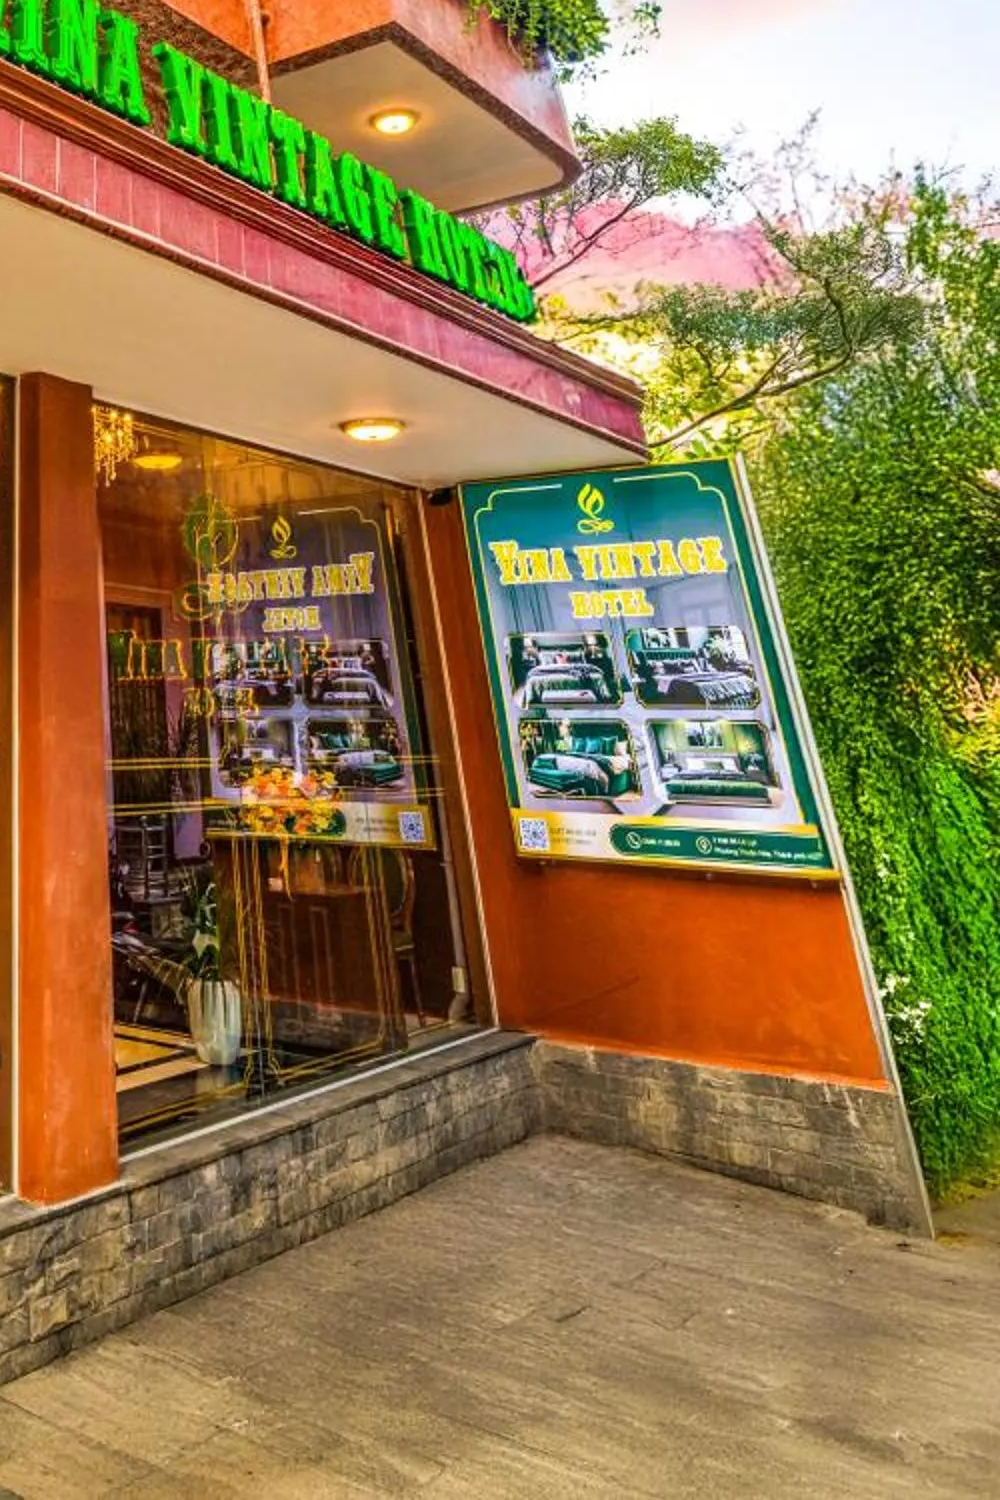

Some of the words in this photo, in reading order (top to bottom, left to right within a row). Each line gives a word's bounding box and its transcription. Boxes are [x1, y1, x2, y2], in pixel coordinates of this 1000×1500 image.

[152, 40, 406, 258] VINTAGE
[398, 187, 536, 323] HOTEL
[488, 540, 573, 586] VINA
[574, 536, 728, 581] VINTAGE
[570, 588, 655, 619] HOTEL
